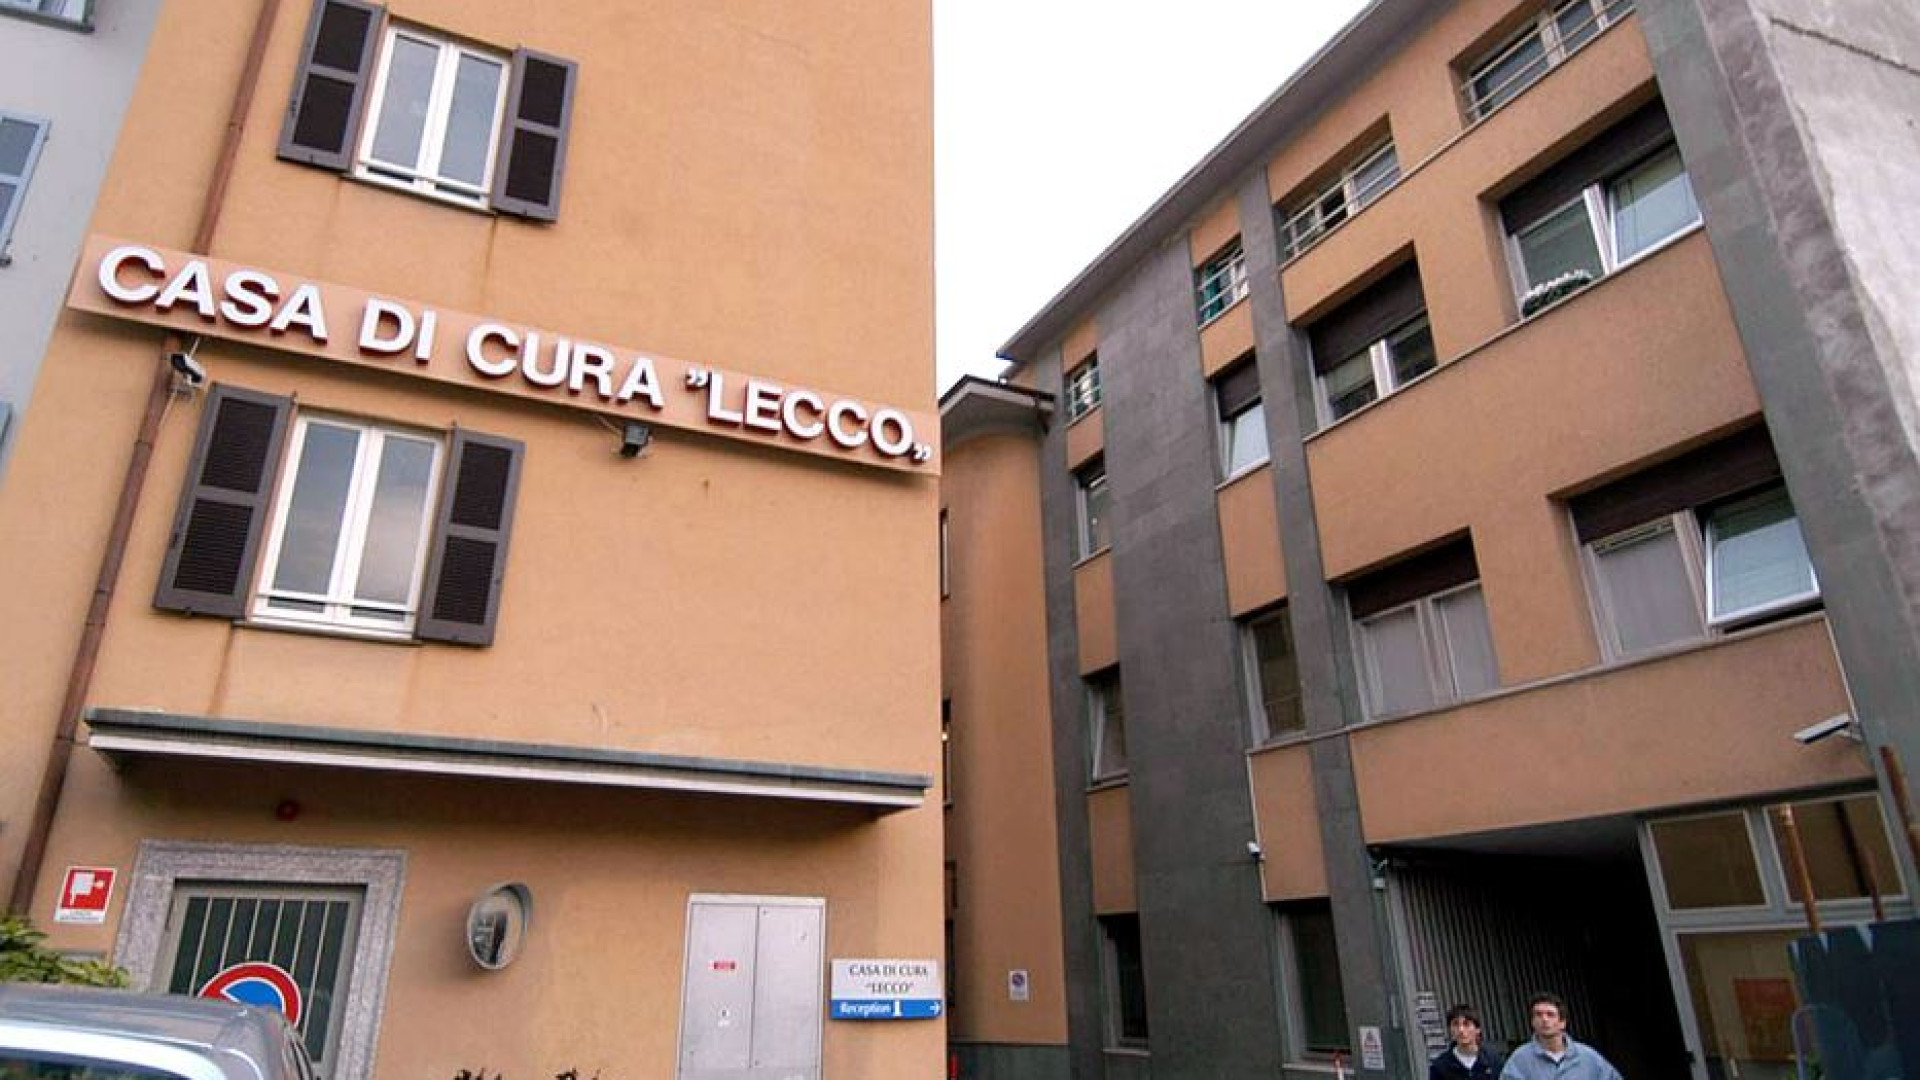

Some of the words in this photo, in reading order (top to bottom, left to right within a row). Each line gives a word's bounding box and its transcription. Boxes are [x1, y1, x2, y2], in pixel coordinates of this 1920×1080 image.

[98, 246, 328, 344] CASA
[359, 296, 436, 365] DI
[465, 322, 666, 411] CURA
[849, 964, 881, 976] CASA
[882, 964, 896, 977] DI
[898, 964, 928, 977] CURA
[840, 1001, 891, 1018] Reception
